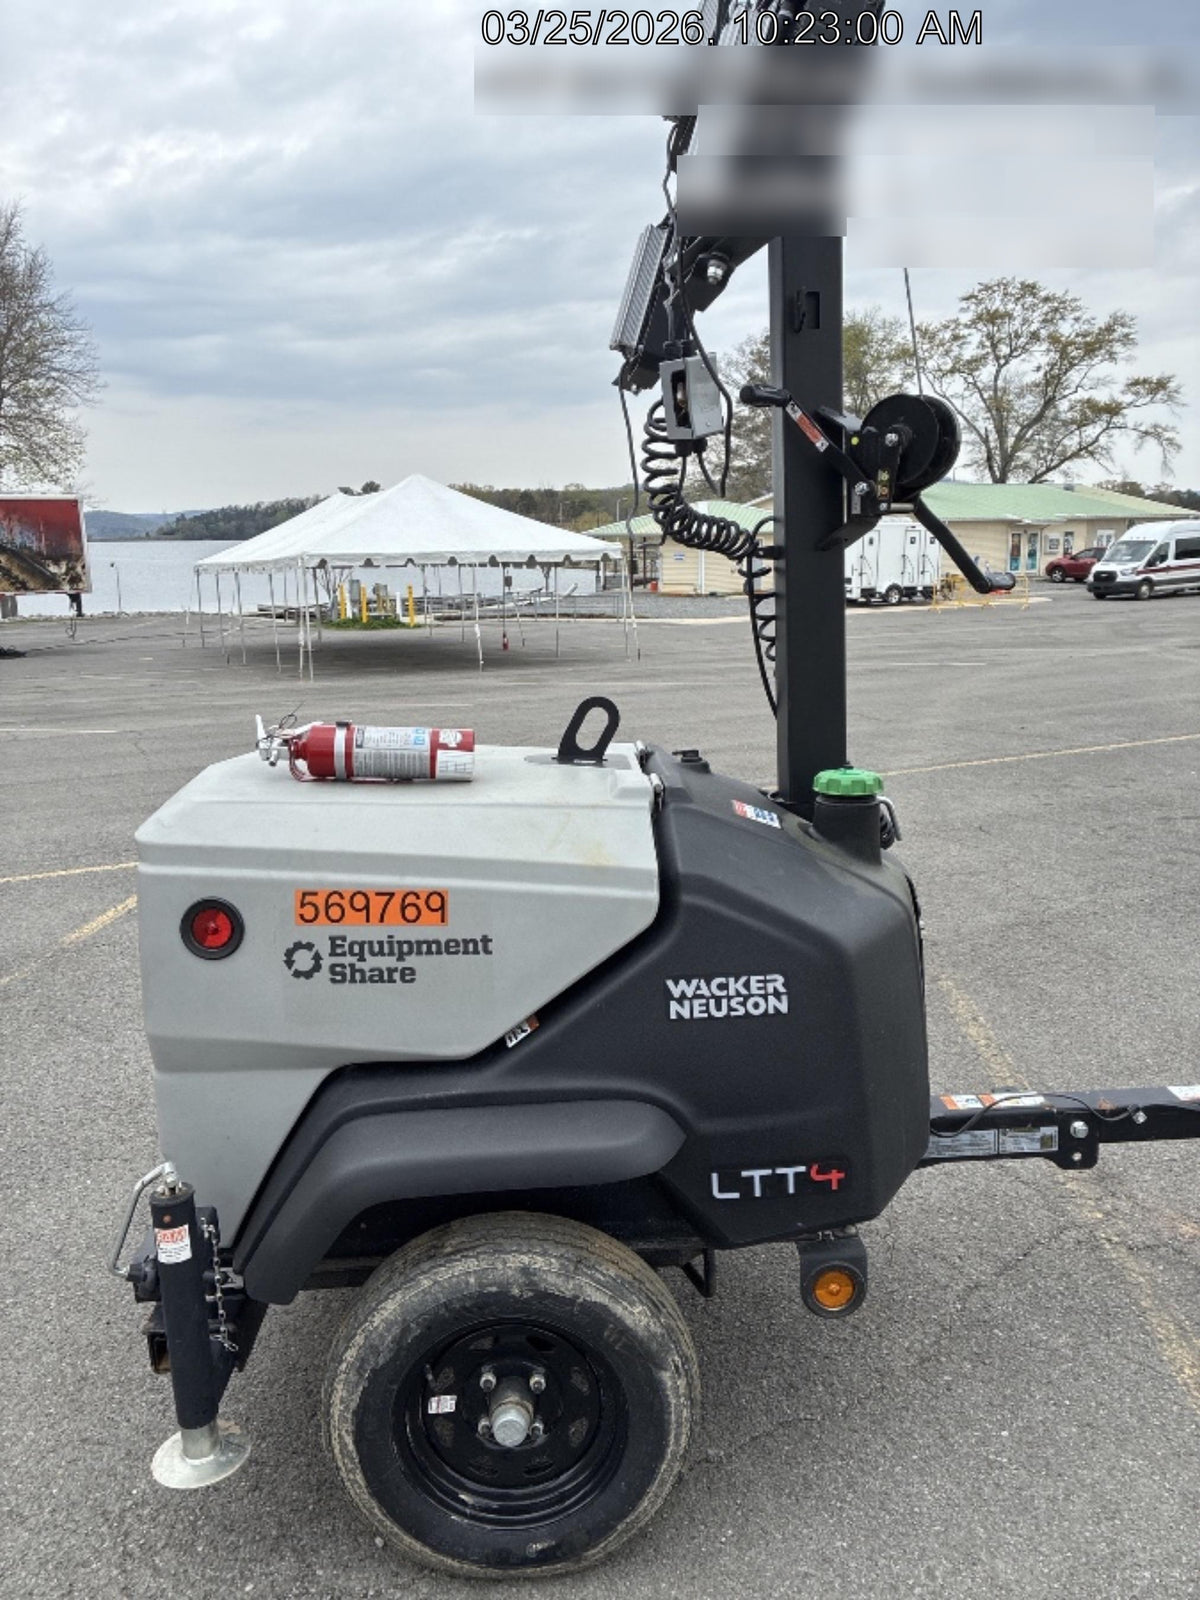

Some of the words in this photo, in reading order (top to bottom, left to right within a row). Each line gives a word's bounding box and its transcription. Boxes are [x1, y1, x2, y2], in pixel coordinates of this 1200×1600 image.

[298, 890, 446, 923] 569769
[328, 934, 494, 962] Equipment
[328, 963, 417, 985] Share
[665, 973, 788, 999] WACKER
[669, 994, 789, 1020] NEUSON
[710, 1163, 846, 1199] LTT4
